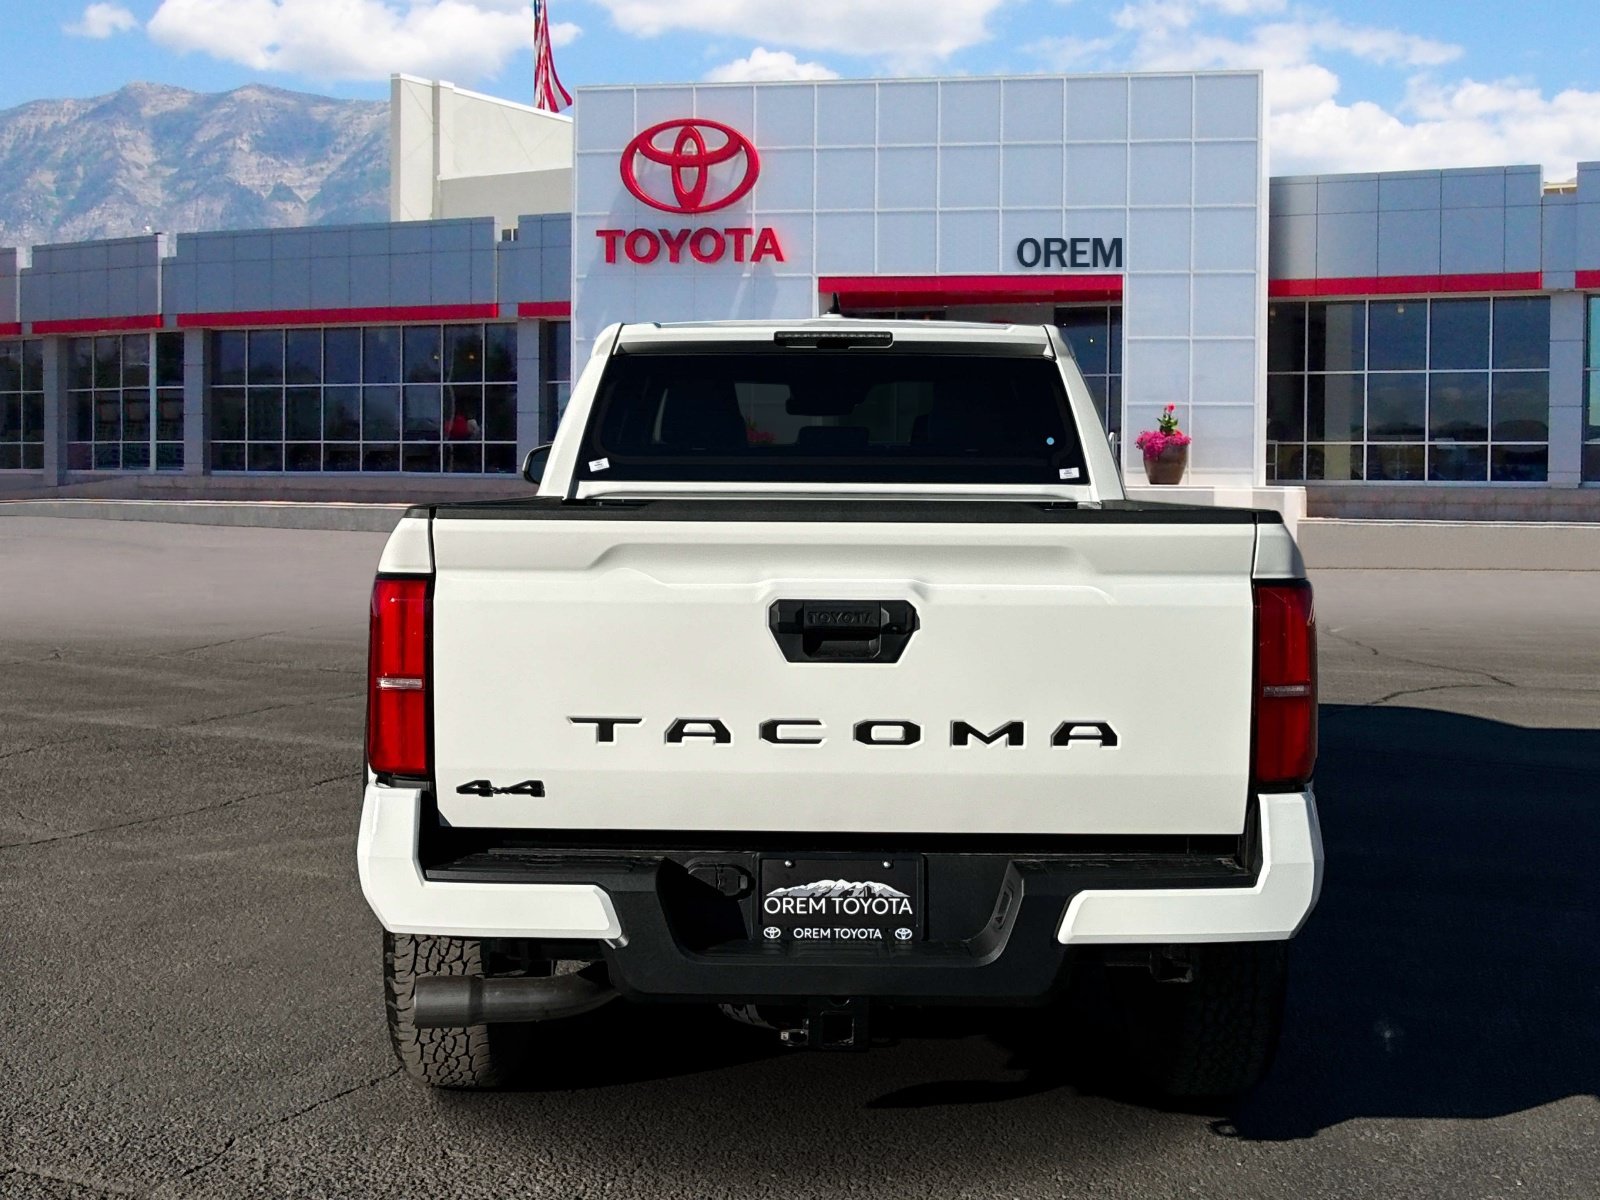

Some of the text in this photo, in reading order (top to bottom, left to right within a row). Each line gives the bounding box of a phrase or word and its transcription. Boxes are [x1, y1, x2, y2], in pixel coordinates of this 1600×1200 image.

[596, 227, 785, 263] TOYOTA
[1016, 237, 1123, 268] OREM
[806, 610, 875, 625] TOYOTA
[568, 716, 1120, 748] TACOMA
[763, 897, 913, 915] OREM TOYOTA
[793, 927, 882, 940] OREM TOYOTA
